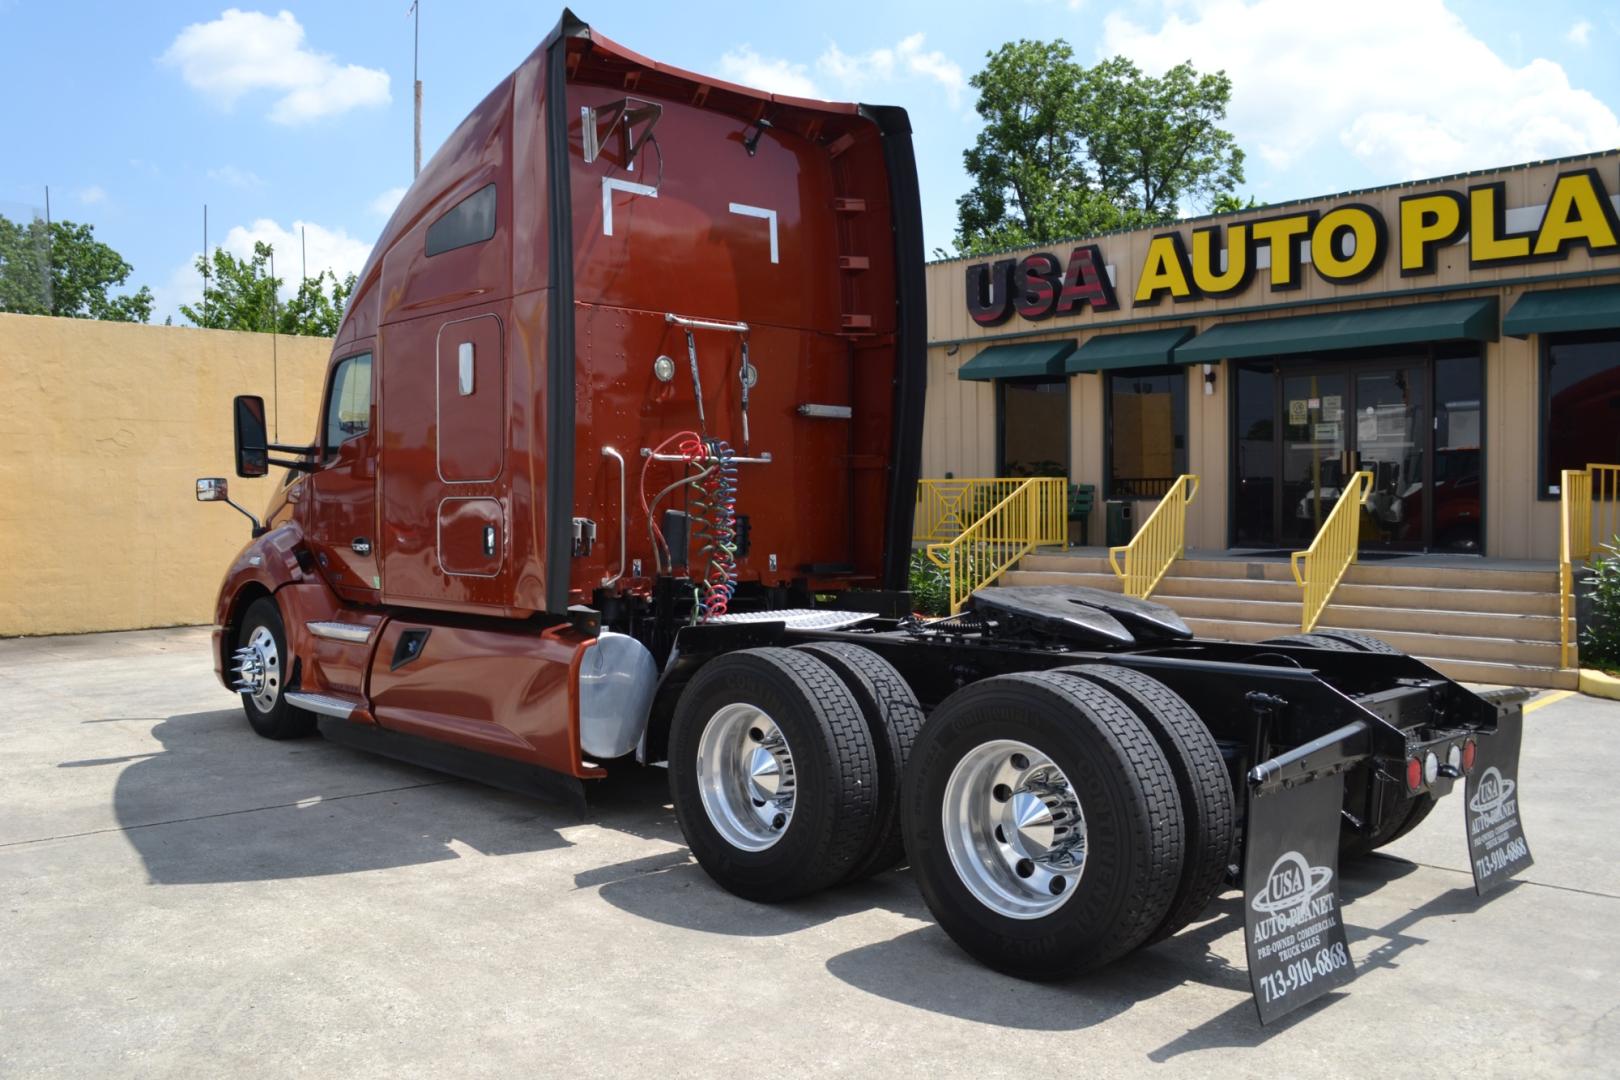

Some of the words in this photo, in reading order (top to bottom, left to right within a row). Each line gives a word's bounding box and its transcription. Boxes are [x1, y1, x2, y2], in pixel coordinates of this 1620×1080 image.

[966, 244, 1119, 327] USA
[1133, 202, 1388, 308] AUTO
[1480, 779, 1499, 803] USA
[1490, 800, 1516, 824] PNET
[1476, 836, 1527, 879] 713-910-6868
[1272, 867, 1303, 899] USA
[1253, 913, 1287, 944] AUTO
[1289, 892, 1334, 928] PLANET
[1257, 934, 1296, 960] PRE-OWNED
[1297, 916, 1336, 941] COMMERCIAL
[1278, 943, 1302, 962] TRUCK
[1301, 935, 1321, 953] SALES
[1260, 941, 1347, 1003] 713-910-6868
